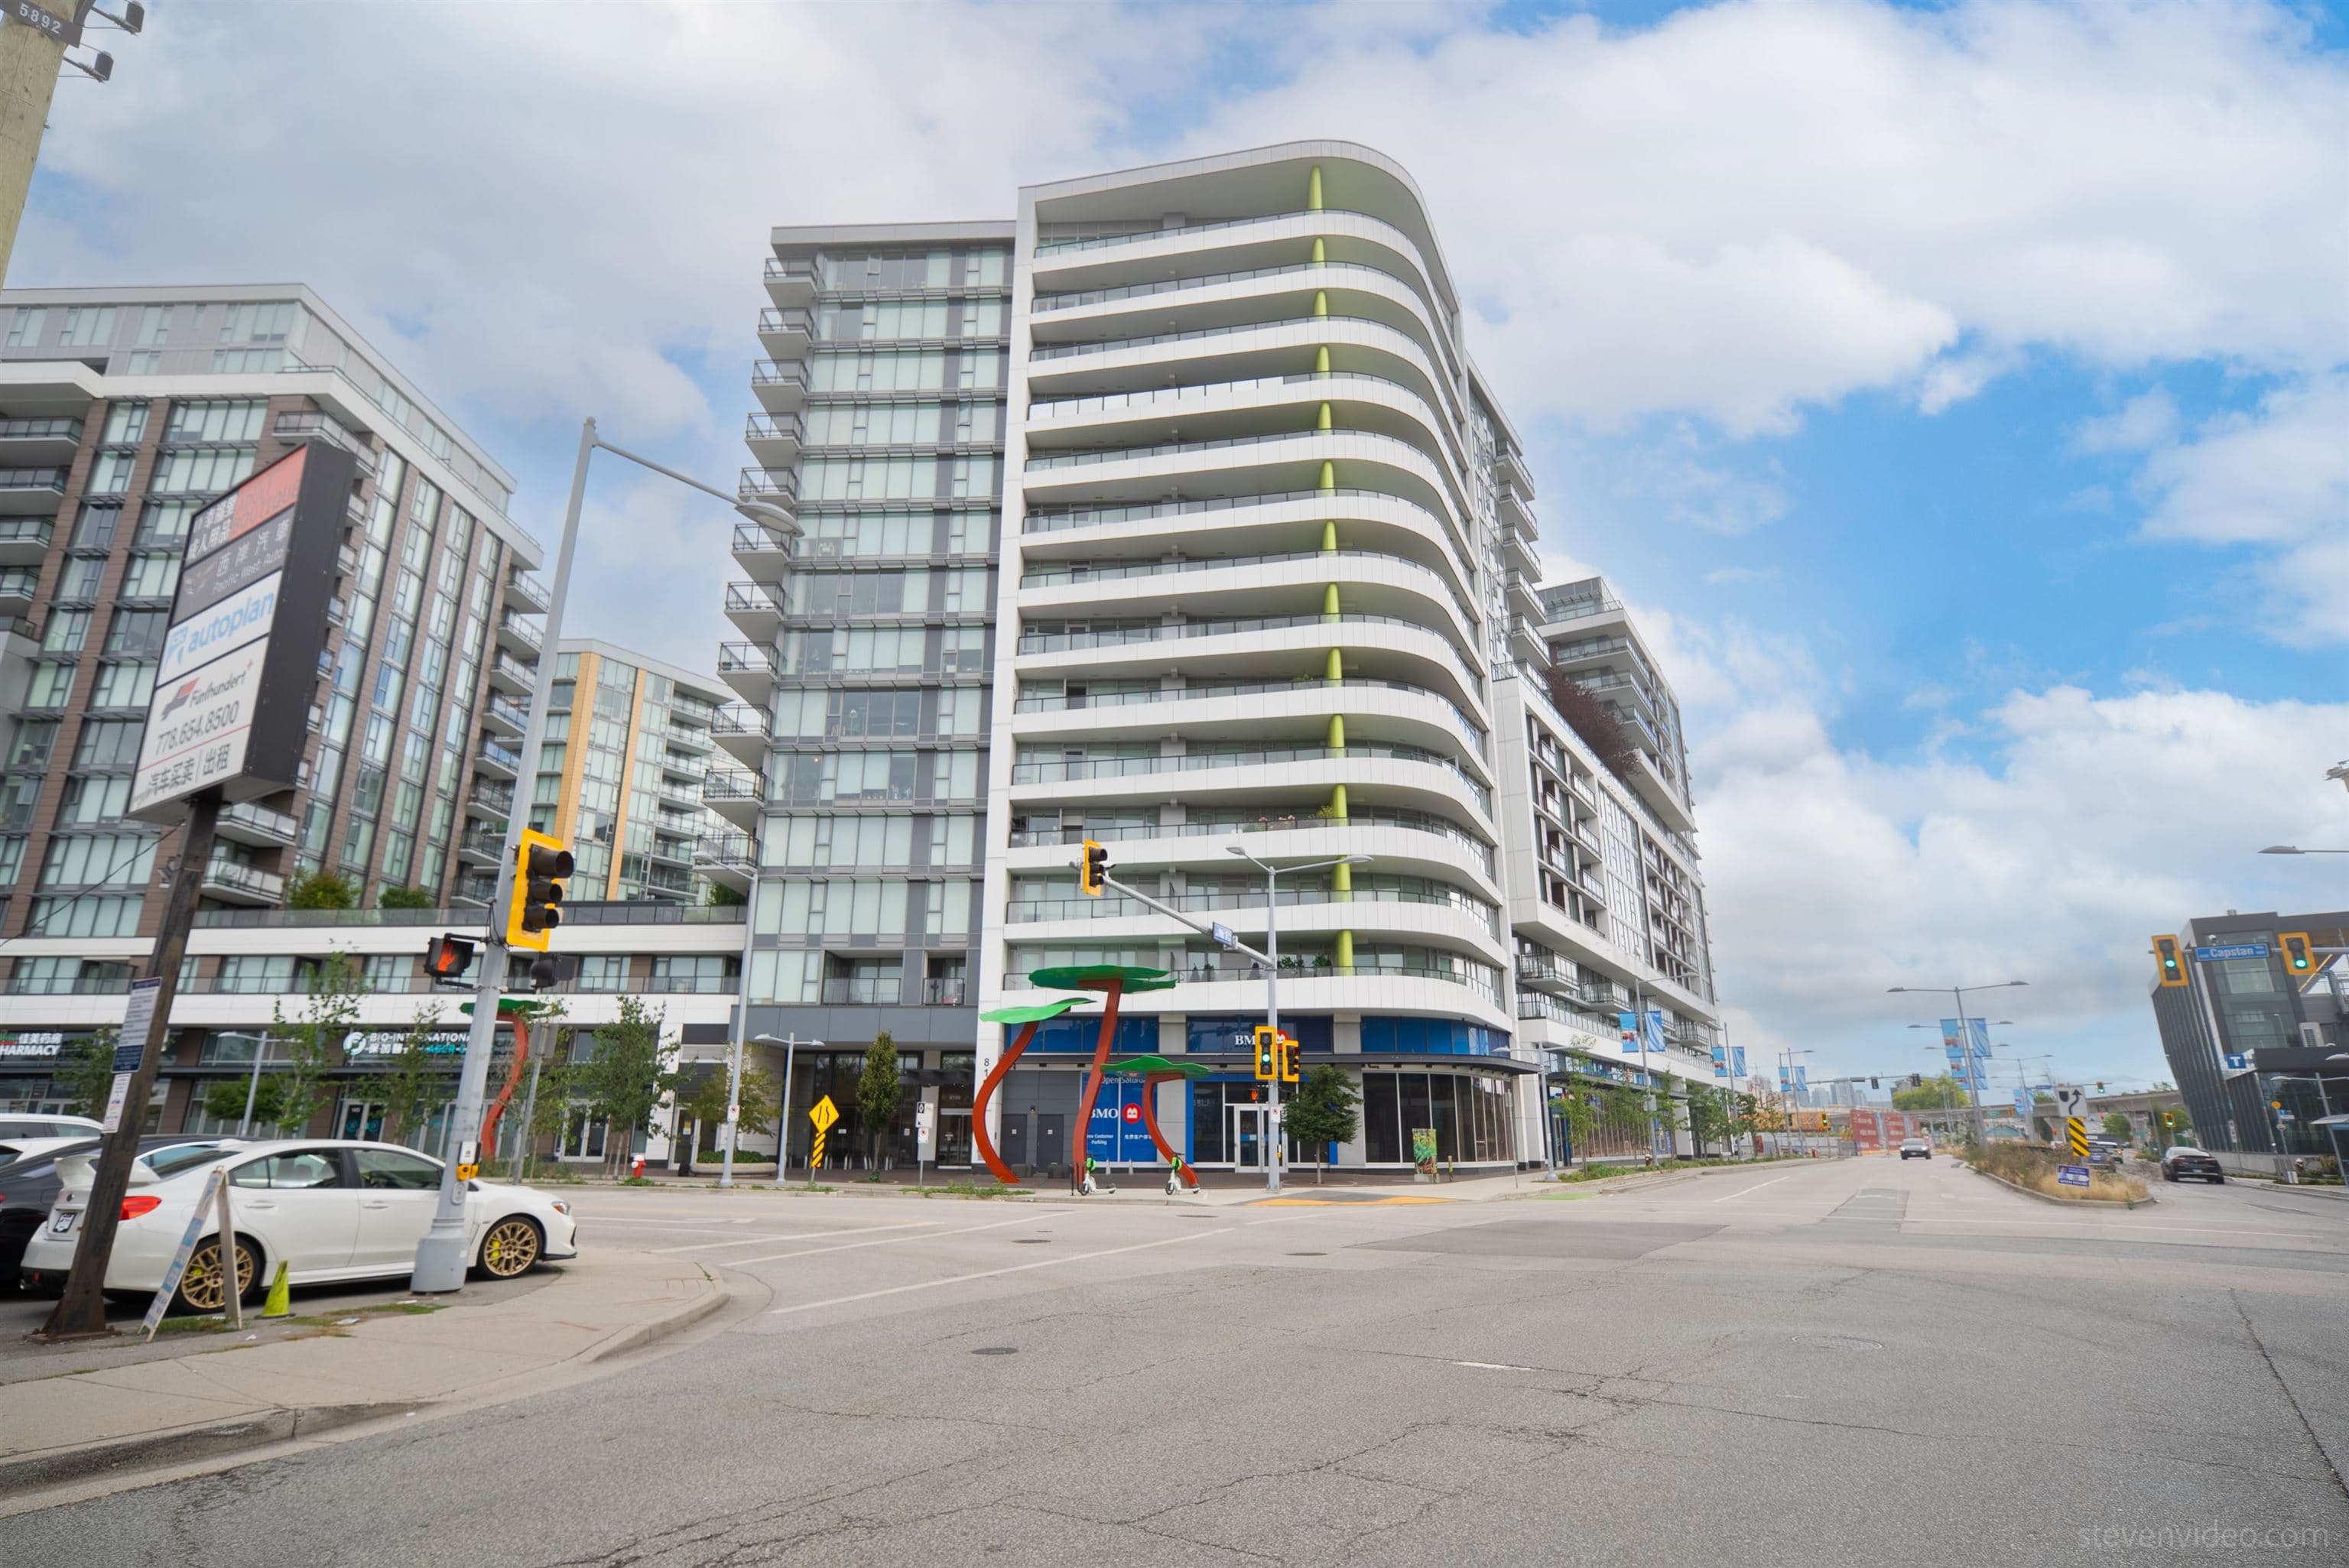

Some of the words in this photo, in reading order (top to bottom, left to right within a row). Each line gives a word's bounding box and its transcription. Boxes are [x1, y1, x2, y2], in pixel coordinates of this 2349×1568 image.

[20, 4, 61, 34] 5892
[187, 518, 232, 560] 成人用品
[262, 548, 284, 566] Auto
[188, 592, 274, 653] autoplan
[155, 700, 239, 756] 778.654.8500
[148, 758, 195, 796] 汽车买卖
[203, 742, 231, 776] 出租
[2210, 947, 2254, 959] Capstan
